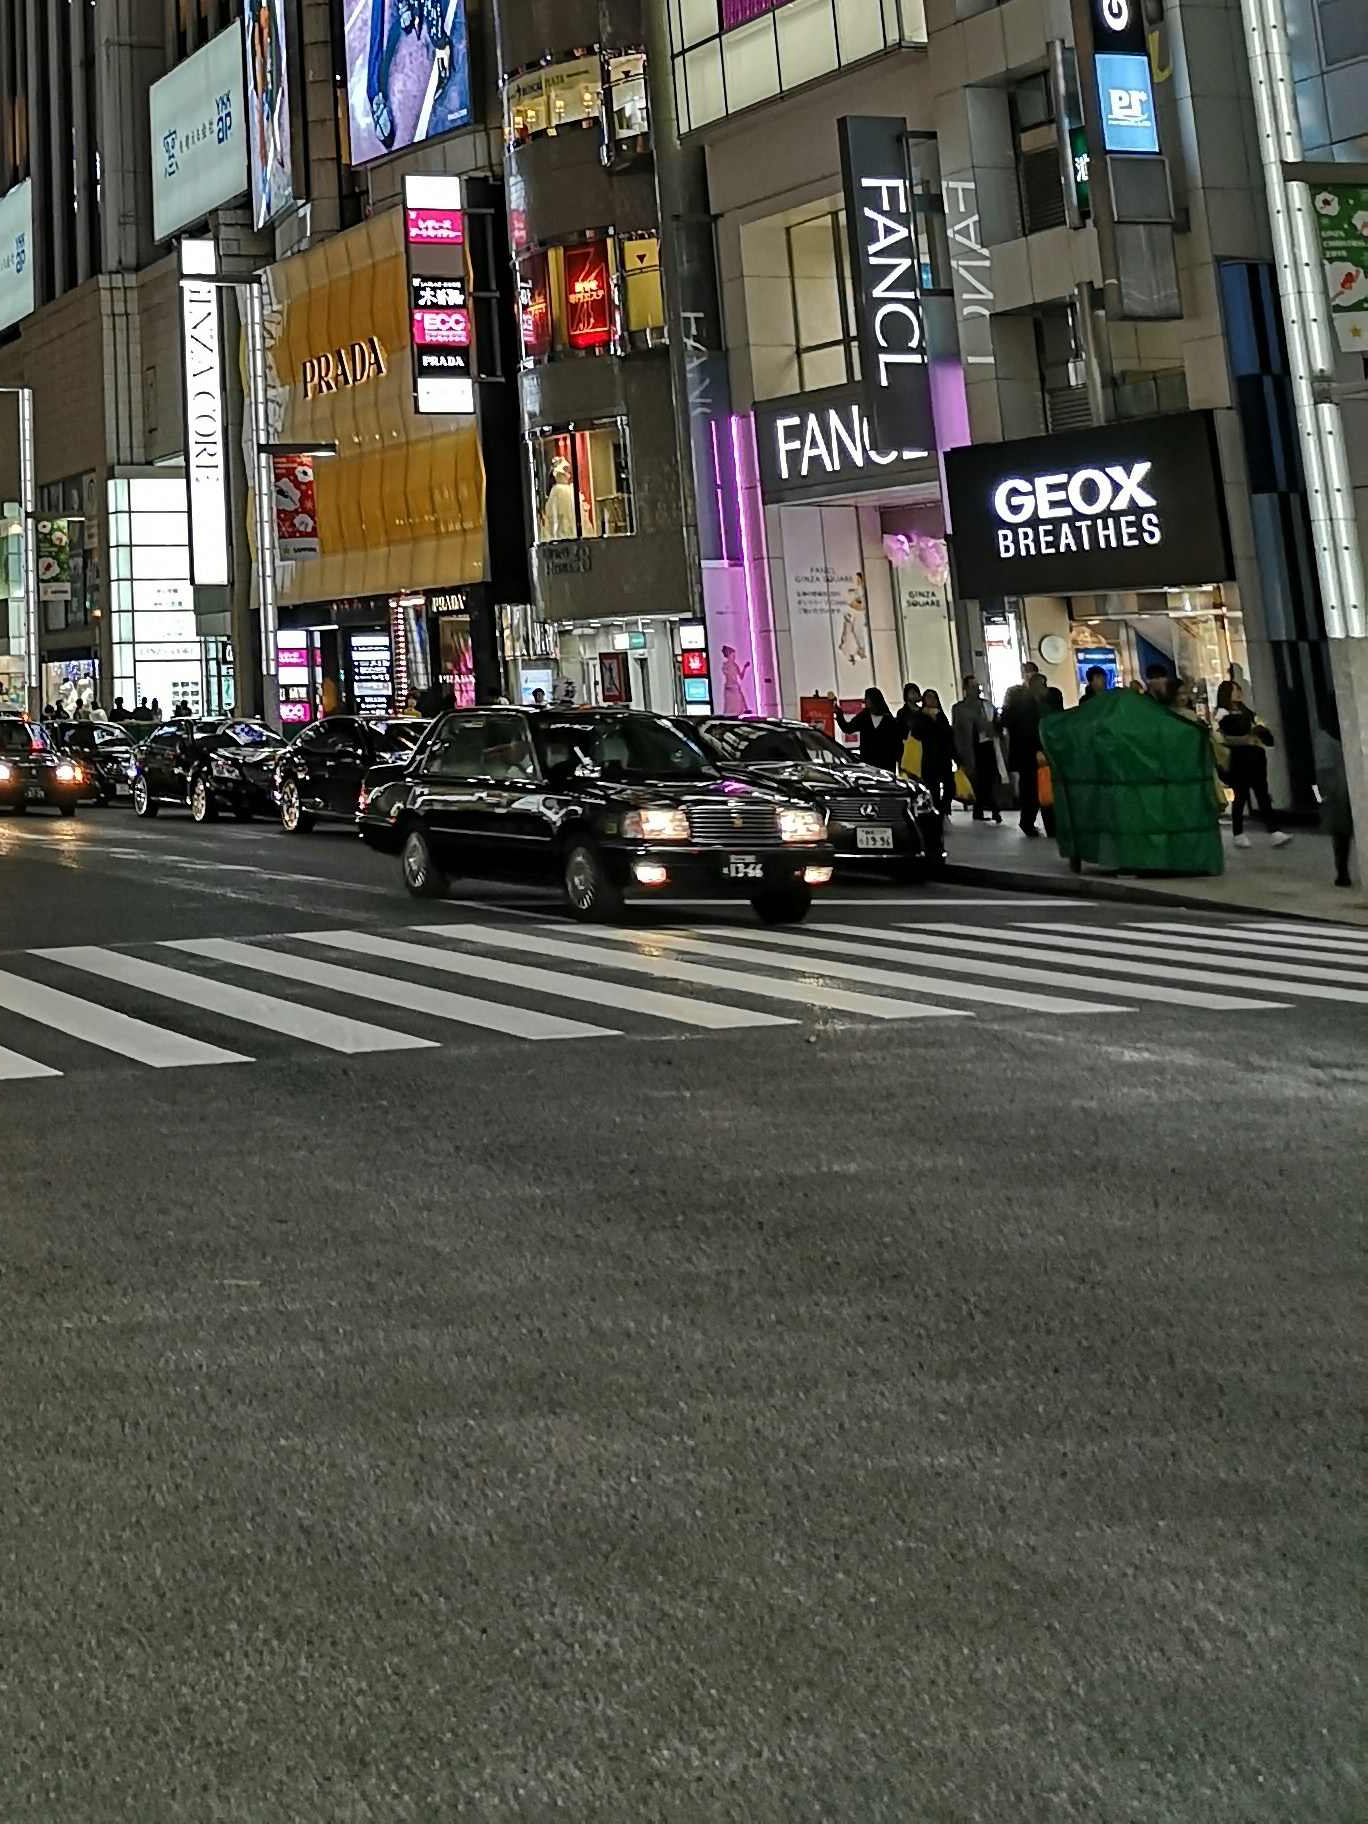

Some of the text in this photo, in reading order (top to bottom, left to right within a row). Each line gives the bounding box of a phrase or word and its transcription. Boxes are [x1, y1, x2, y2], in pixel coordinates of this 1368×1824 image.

[860, 177, 923, 387] FANCL
[423, 313, 466, 332] ECC
[301, 335, 389, 401] PRADA
[422, 355, 465, 367] PRADA
[776, 404, 929, 479] FAN
[993, 460, 1158, 524] GEOX
[997, 512, 1162, 559] BREATHES
[432, 594, 467, 613] PRADA
[906, 599, 942, 609] SQUARE
[908, 590, 938, 599] GINZA
